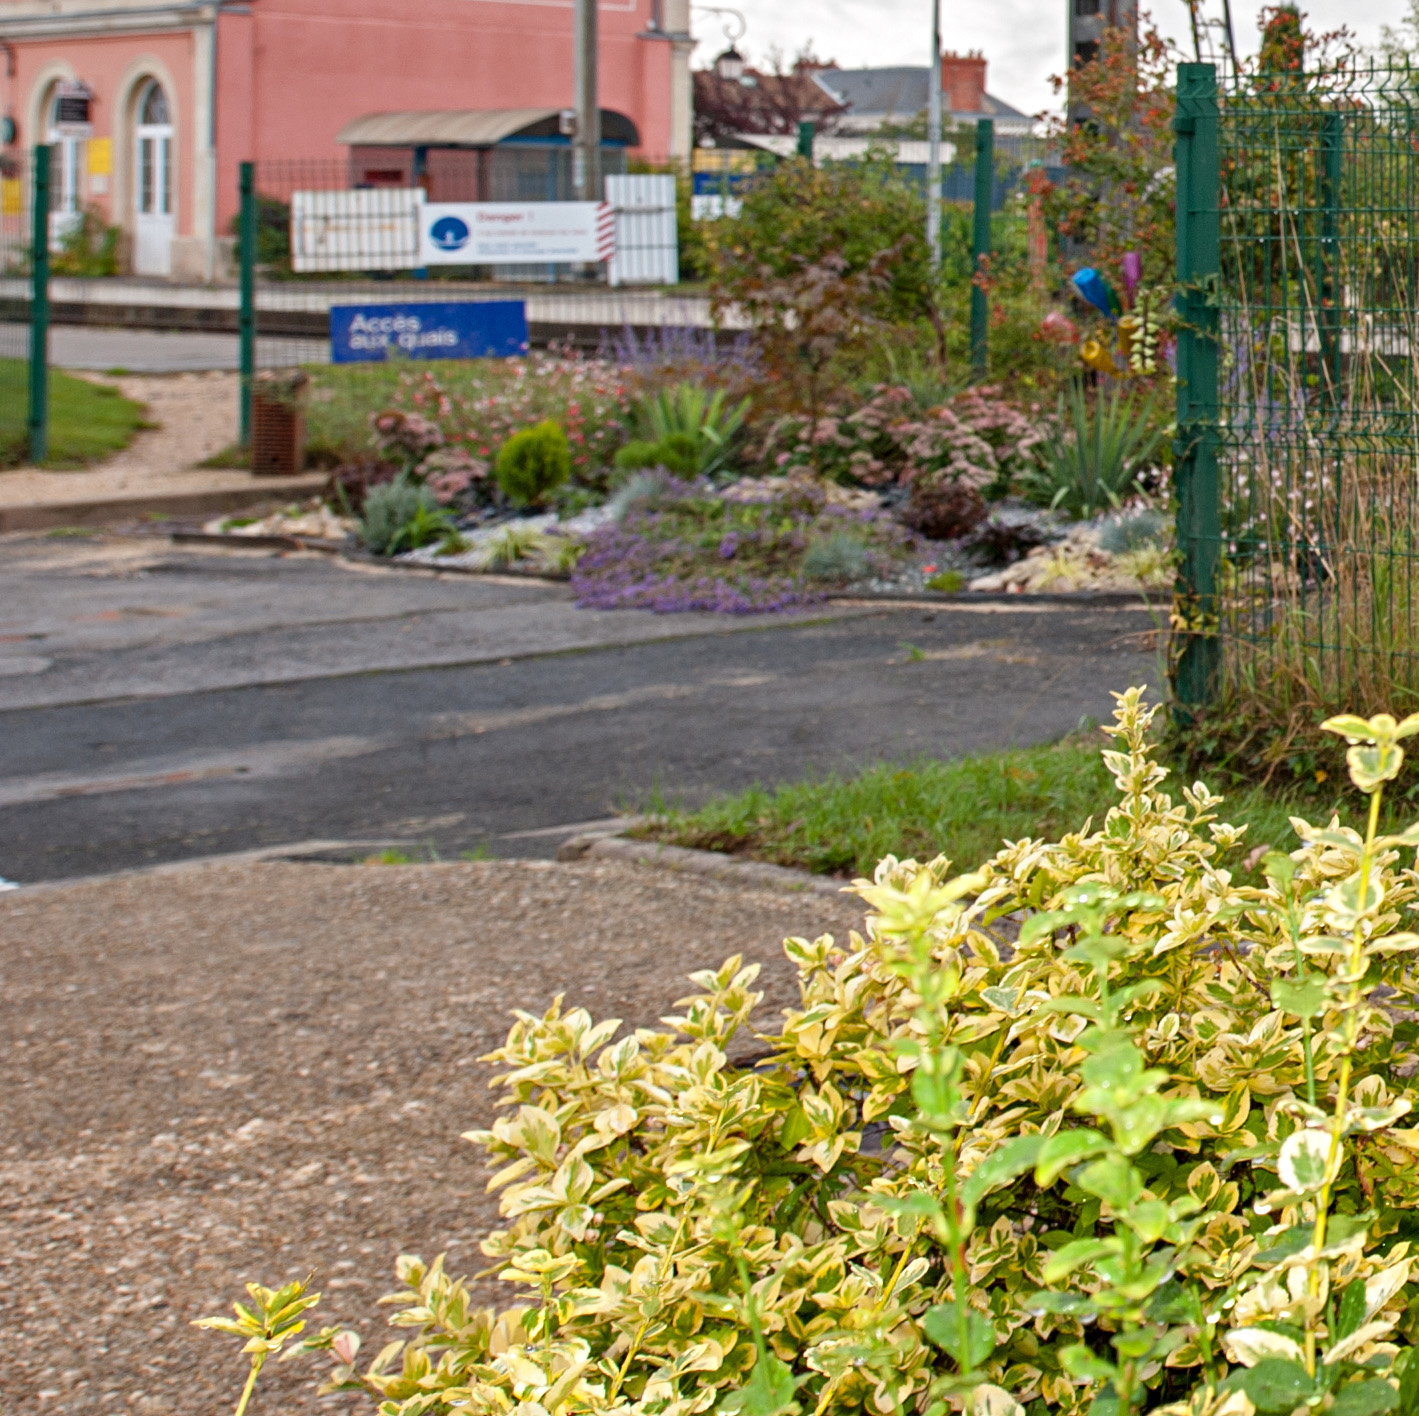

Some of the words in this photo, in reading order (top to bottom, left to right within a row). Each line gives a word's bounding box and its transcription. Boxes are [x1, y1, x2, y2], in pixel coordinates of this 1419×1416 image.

[349, 313, 421, 334] Accès
[349, 333, 389, 350] aux
[398, 328, 459, 351] quais
